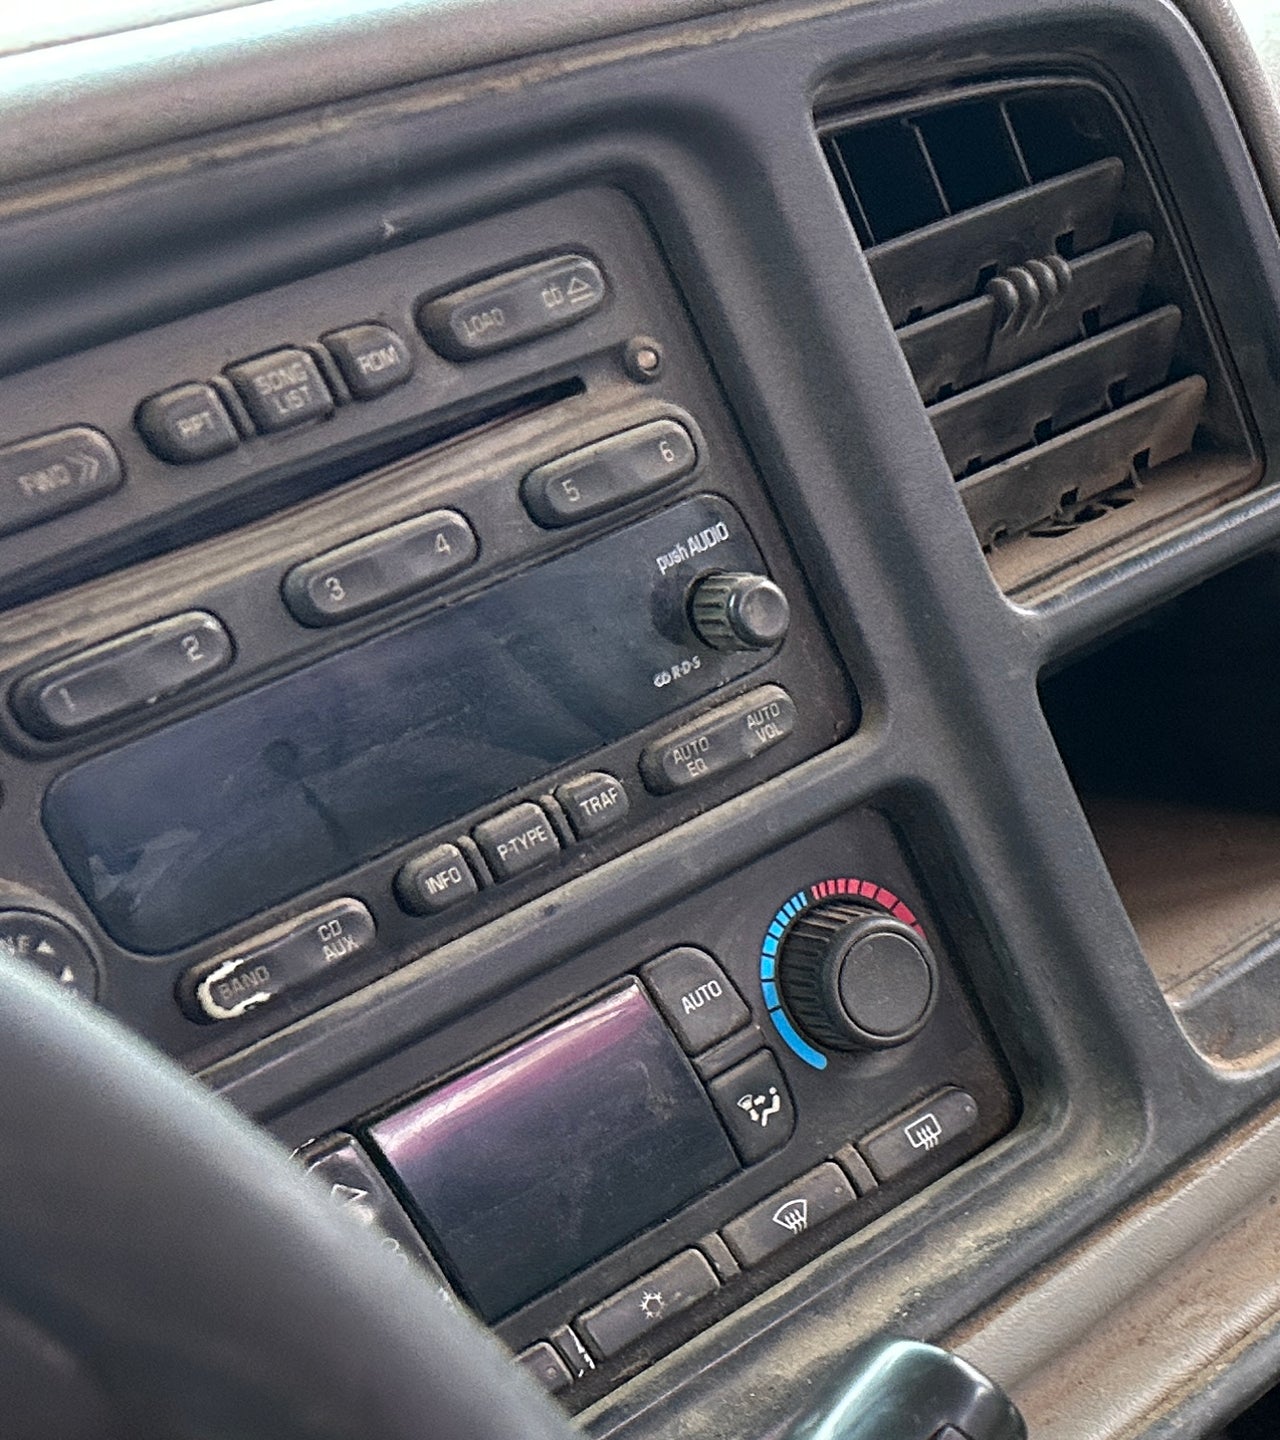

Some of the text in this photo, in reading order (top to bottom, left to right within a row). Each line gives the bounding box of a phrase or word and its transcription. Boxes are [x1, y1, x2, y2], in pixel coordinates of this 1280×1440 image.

[357, 346, 400, 375] RDM
[254, 362, 307, 397] SONG
[274, 385, 313, 415] LIST
[659, 442, 674, 463] 6
[562, 481, 582, 502] 5
[433, 533, 452, 555] 4
[656, 521, 731, 575] push AUDIO
[325, 577, 347, 602] 3
[181, 636, 205, 661] 2
[59, 688, 75, 712] 1
[746, 704, 781, 731] AUTO
[755, 722, 783, 744] VOL
[672, 736, 710, 766] AUTO
[687, 759, 709, 778] EQ
[579, 787, 620, 817] TRAF
[496, 824, 549, 862] P-TYPE
[424, 865, 462, 895] INFO
[317, 919, 342, 942] CD
[322, 937, 358, 963] AUX
[218, 966, 270, 1000] BAND
[681, 980, 723, 1014] AUTO
